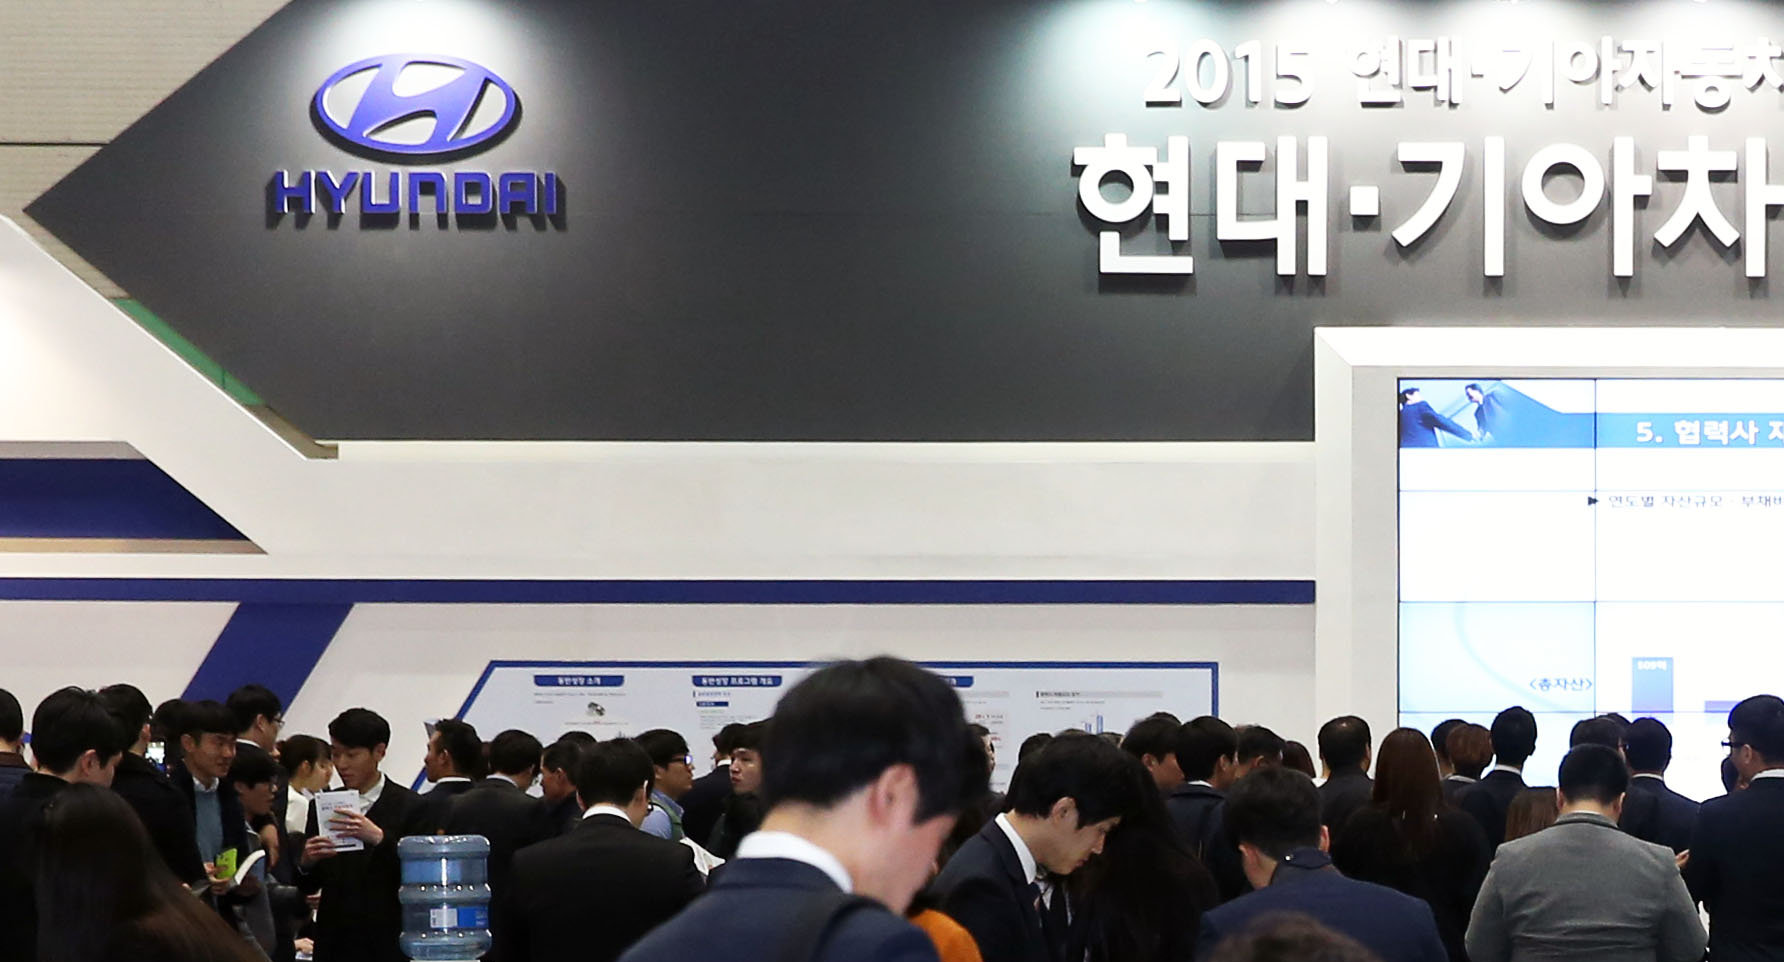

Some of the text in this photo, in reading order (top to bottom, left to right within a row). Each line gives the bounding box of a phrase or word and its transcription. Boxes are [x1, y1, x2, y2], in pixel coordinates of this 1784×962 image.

[1143, 38, 1314, 105] 2015
[273, 169, 558, 214] HYUNDAI
[1635, 420, 1664, 444] 5.
[1673, 419, 1760, 445] 협력사
